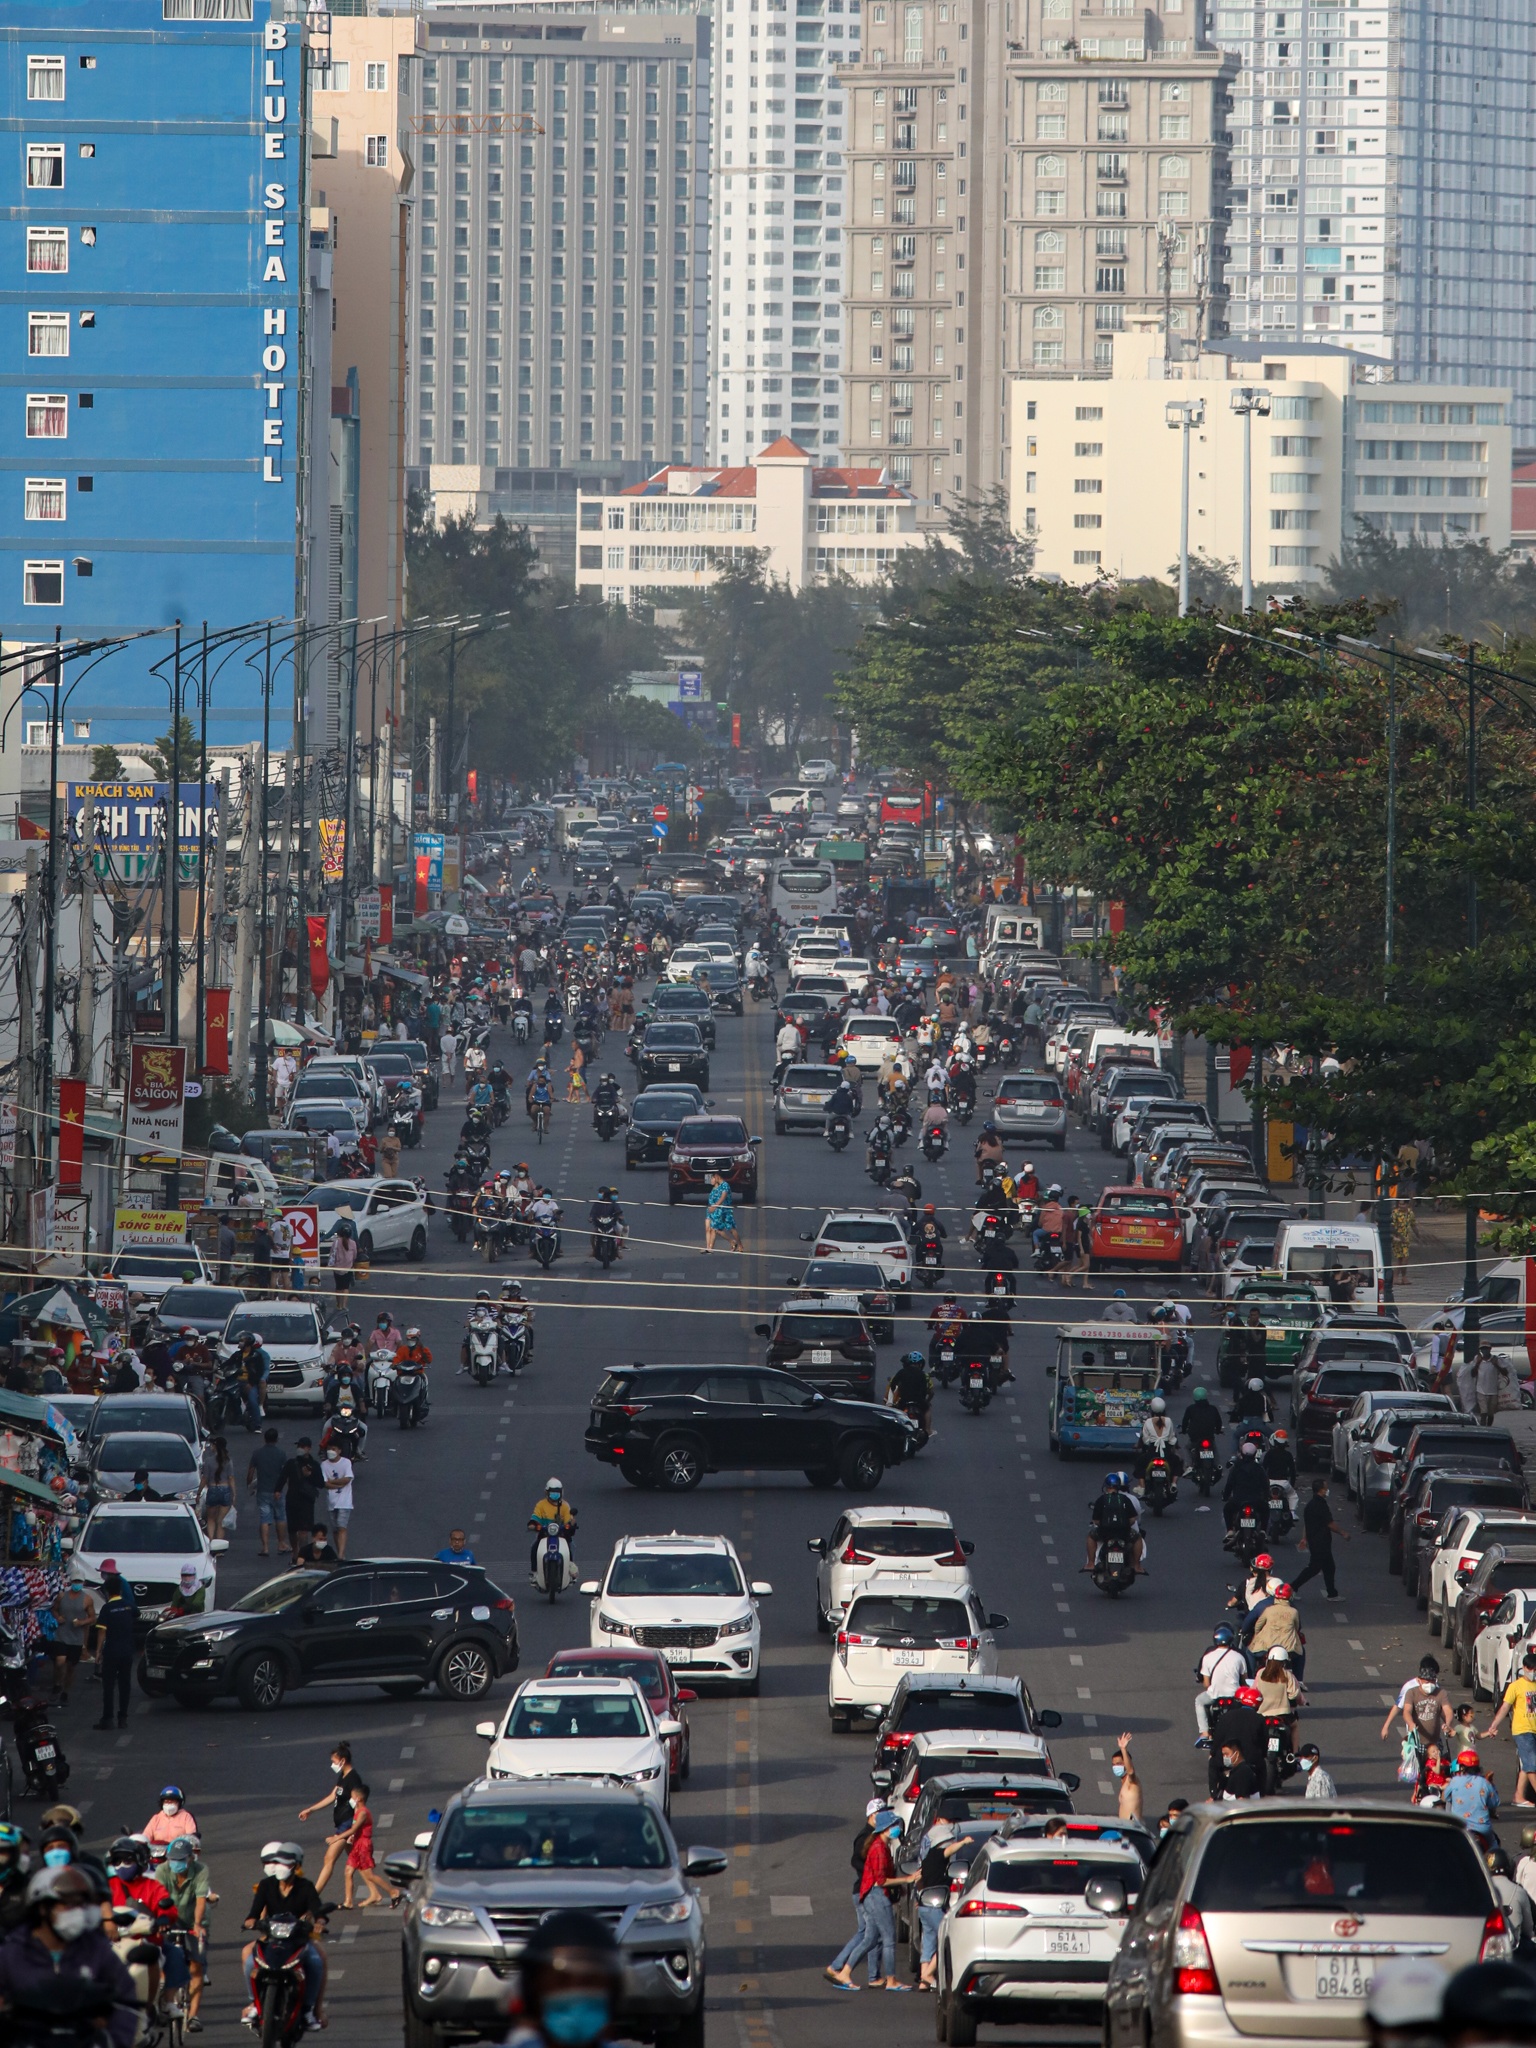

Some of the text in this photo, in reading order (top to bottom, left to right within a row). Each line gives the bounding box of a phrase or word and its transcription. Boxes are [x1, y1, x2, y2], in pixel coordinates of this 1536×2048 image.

[262, 23, 287, 483] BLUE SEA HOTEL
[75, 782, 154, 801] KHÁCH SẠN
[135, 1087, 178, 1100] SAIGON
[132, 1116, 179, 1127] NHÀ NGHỈ
[149, 1131, 160, 1139] 41
[141, 1212, 166, 1220] QUÁN
[119, 1220, 183, 1232] SÓNG BIỂN
[289, 1218, 313, 1237] K
[1057, 1932, 1076, 1941] 61A
[1050, 1943, 1083, 1951] 996.41
[1330, 1958, 1360, 1975] 61A
[1318, 1978, 1372, 1995] 084.86
